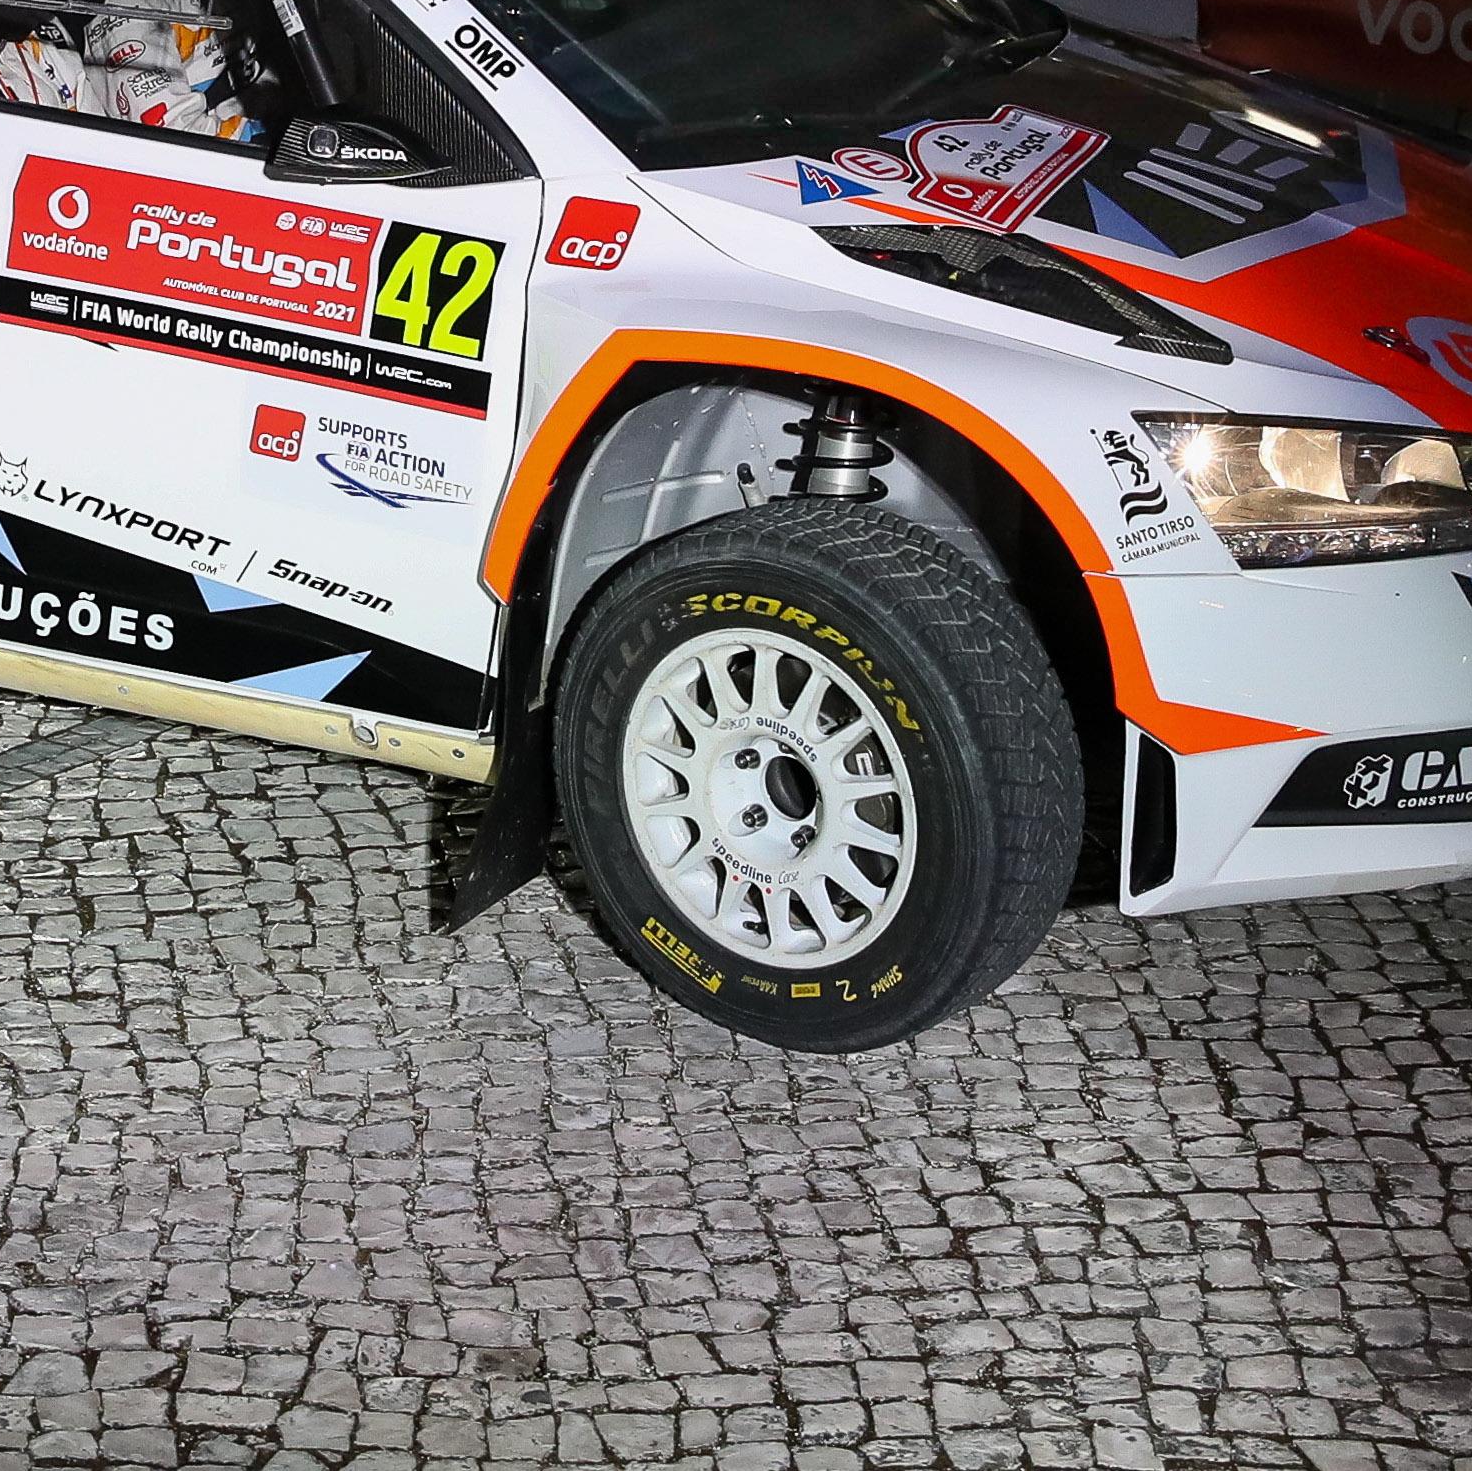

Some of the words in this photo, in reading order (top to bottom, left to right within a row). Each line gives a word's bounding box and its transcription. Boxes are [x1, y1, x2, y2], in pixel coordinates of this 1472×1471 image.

[454, 24, 517, 79] OMP
[340, 145, 408, 162] ŠKODA
[933, 134, 971, 154] 42
[979, 128, 1053, 181] Portugal
[132, 202, 182, 227] rally
[187, 210, 218, 228] de
[22, 230, 110, 261] vodafone
[126, 218, 358, 292] Portugal
[559, 236, 623, 267] acp
[162, 277, 219, 297] AUTOMÓVEL
[220, 287, 245, 302] CLUB
[245, 292, 259, 305] DE
[259, 295, 309, 314] PORTUGAL
[313, 300, 356, 323] 2021
[374, 231, 496, 360] 42
[82, 299, 112, 324] FIA
[117, 307, 171, 334] World
[176, 319, 223, 349] Rally
[228, 329, 363, 376] Championship
[257, 432, 299, 457] acp
[318, 416, 409, 450] SUPPORTS
[347, 442, 371, 460] FIA
[374, 448, 446, 478] ACTION
[344, 459, 366, 474] FOR
[369, 465, 410, 487] ROAD
[414, 477, 474, 501] SAFETY
[33, 478, 232, 558] LYNXPORT
[1116, 526, 1158, 550] SANTO
[1157, 515, 1196, 540] TIRSO
[1121, 544, 1158, 564] CÂMARA
[1156, 532, 1202, 557] MUNICIPAL
[188, 559, 218, 576] .COM
[267, 557, 394, 616] Snap-on
[755, 716, 819, 764] speedline
[712, 837, 773, 885] speedline
